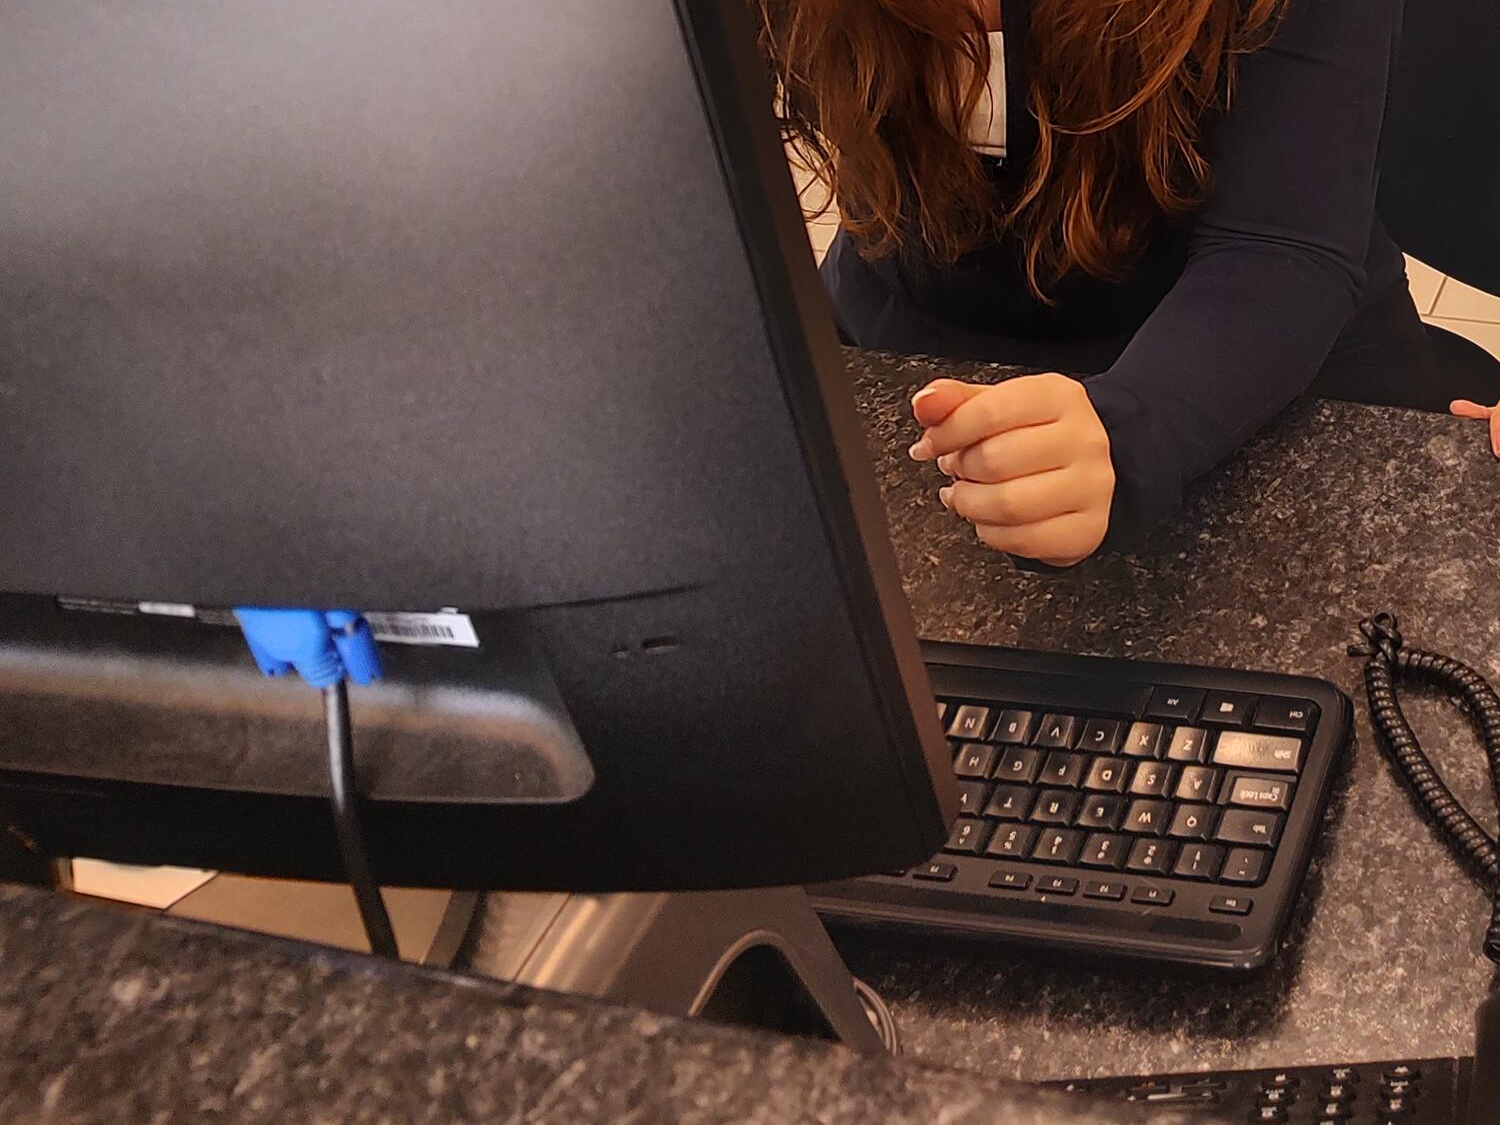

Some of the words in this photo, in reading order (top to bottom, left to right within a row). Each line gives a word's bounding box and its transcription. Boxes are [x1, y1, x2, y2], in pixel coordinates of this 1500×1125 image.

[965, 718, 976, 729] N
[1009, 722, 1017, 733] B
[1051, 727, 1060, 738] V
[1095, 731, 1105, 742] C
[1139, 735, 1149, 746] X
[1183, 740, 1193, 751] Z
[969, 756, 980, 767] H
[1013, 761, 1023, 771] G
[1058, 765, 1066, 776] F
[1102, 769, 1113, 781] D
[1147, 774, 1156, 785] S
[1194, 779, 1203, 790] A
[960, 793, 968, 804] Y
[1239, 789, 1258, 801] Lock
[1257, 791, 1279, 802] Caps
[1003, 796, 1013, 809] T
[1049, 802, 1060, 814] R
[1096, 807, 1105, 818] E
[1138, 812, 1151, 824] W
[1186, 815, 1198, 828] Q
[1252, 824, 1267, 835] Tab
